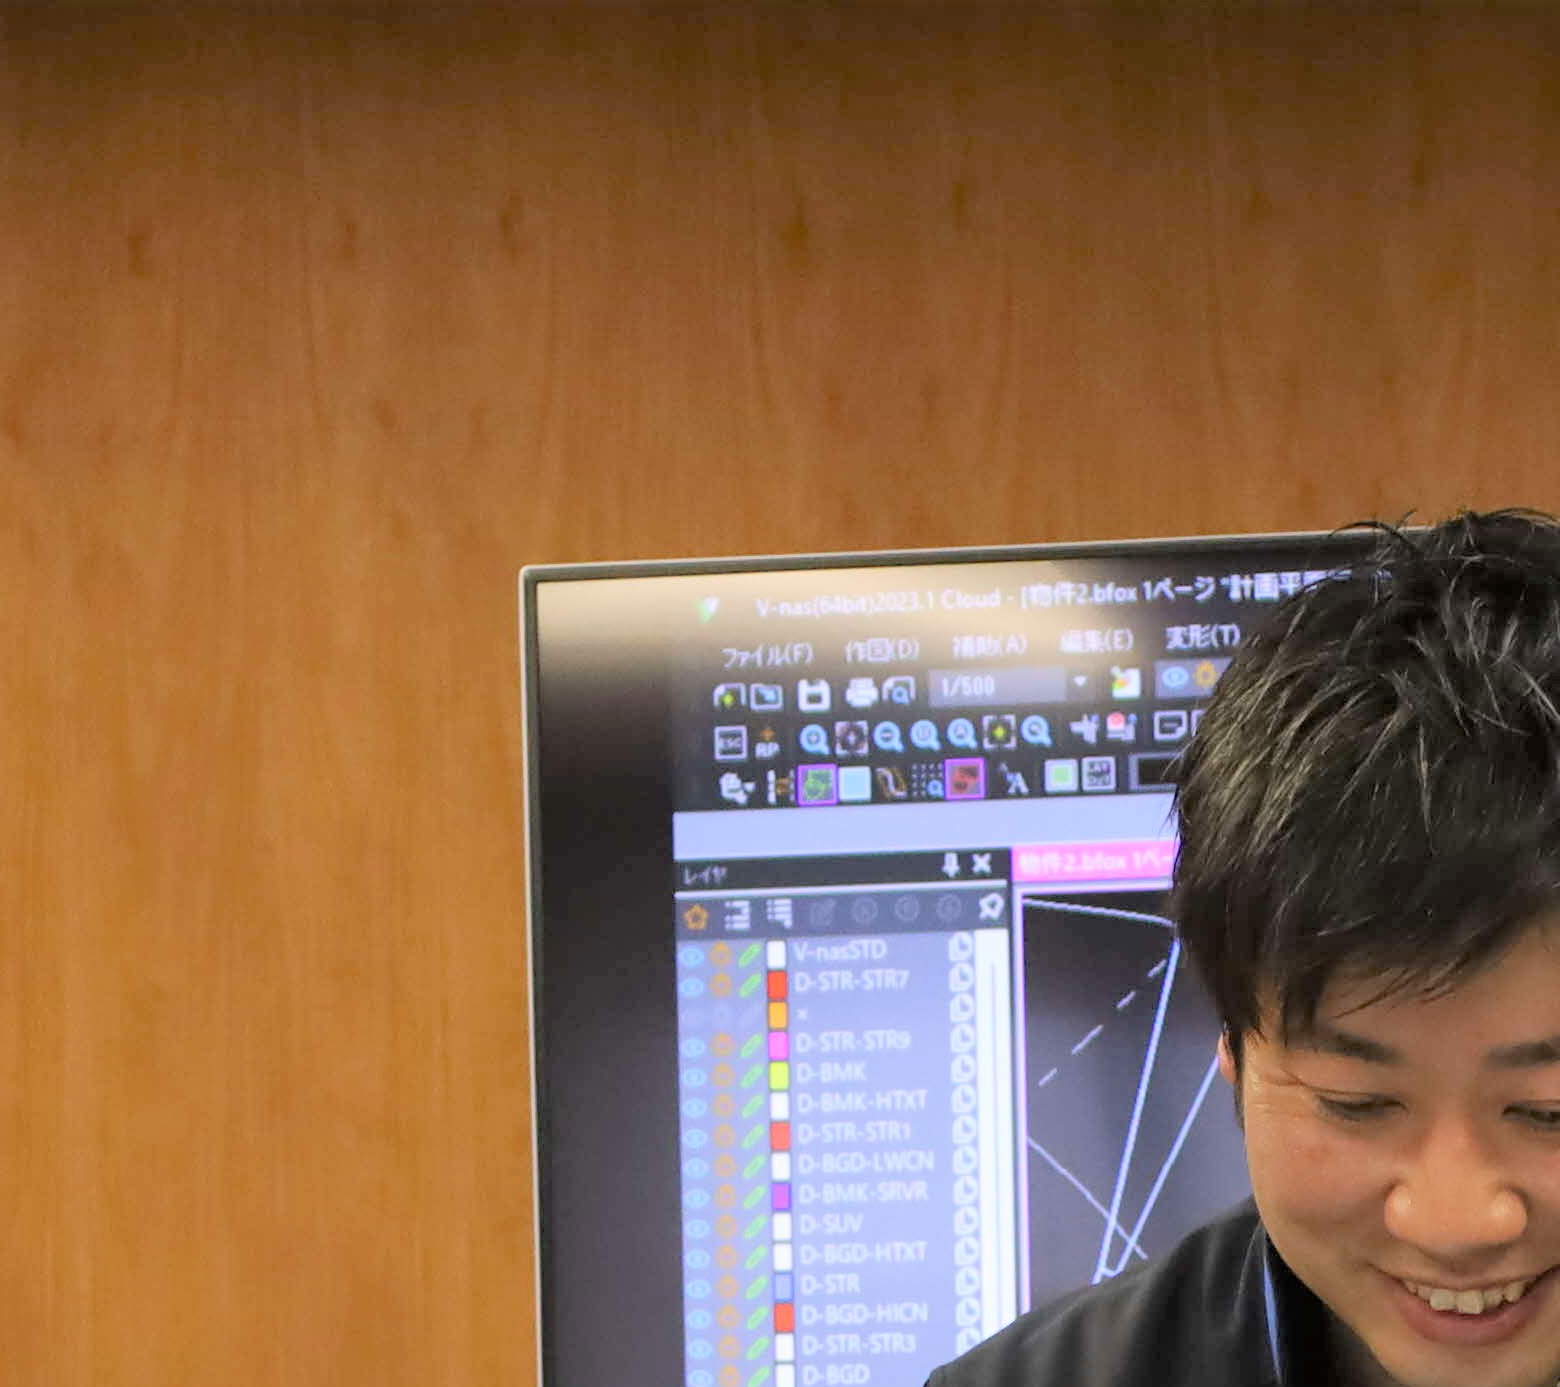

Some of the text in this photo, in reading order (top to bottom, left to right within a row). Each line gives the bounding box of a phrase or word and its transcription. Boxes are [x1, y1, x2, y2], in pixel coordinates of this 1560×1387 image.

[942, 588, 1002, 609] Cloud
[1059, 628, 1134, 653] 編集(E)
[1165, 623, 1240, 651] 変形(T)
[721, 642, 814, 671] ファイル(F)
[845, 638, 920, 663] 作図(D)
[941, 676, 995, 697] 1/500
[797, 1062, 867, 1084] D-BMK
[801, 1273, 861, 1296] D-STR
[802, 1364, 871, 1386] D-BGD
